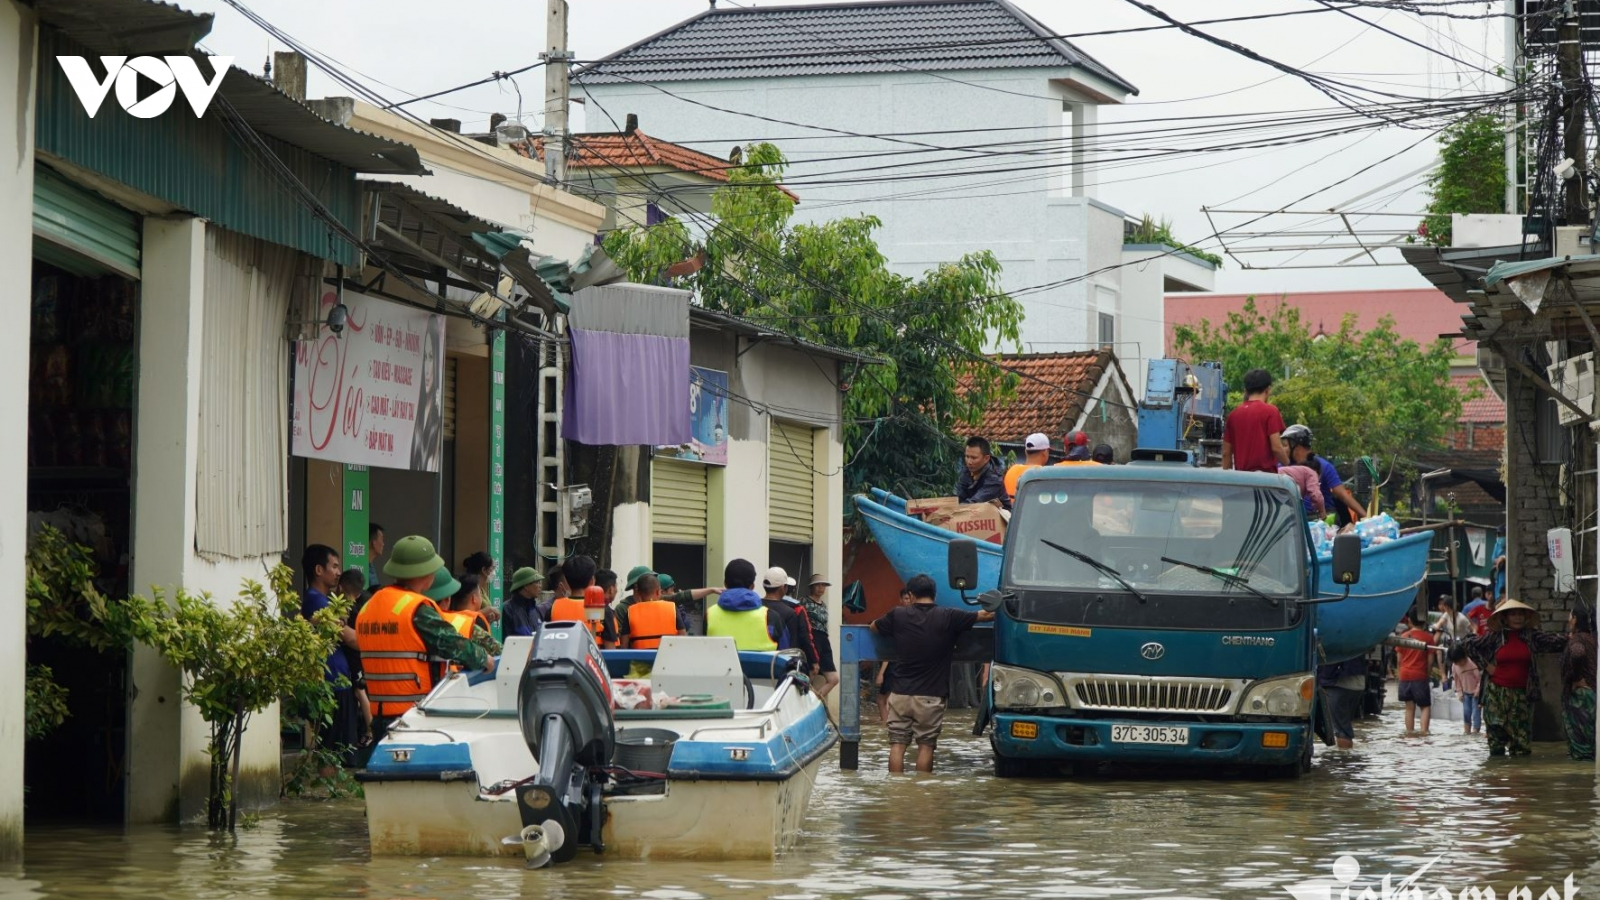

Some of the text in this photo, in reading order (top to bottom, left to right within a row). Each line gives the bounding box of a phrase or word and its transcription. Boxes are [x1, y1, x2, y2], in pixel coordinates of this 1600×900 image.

[351, 489, 363, 511] AN
[956, 519, 996, 533] KISSHU
[1113, 726, 1186, 743] 37C-305.34
